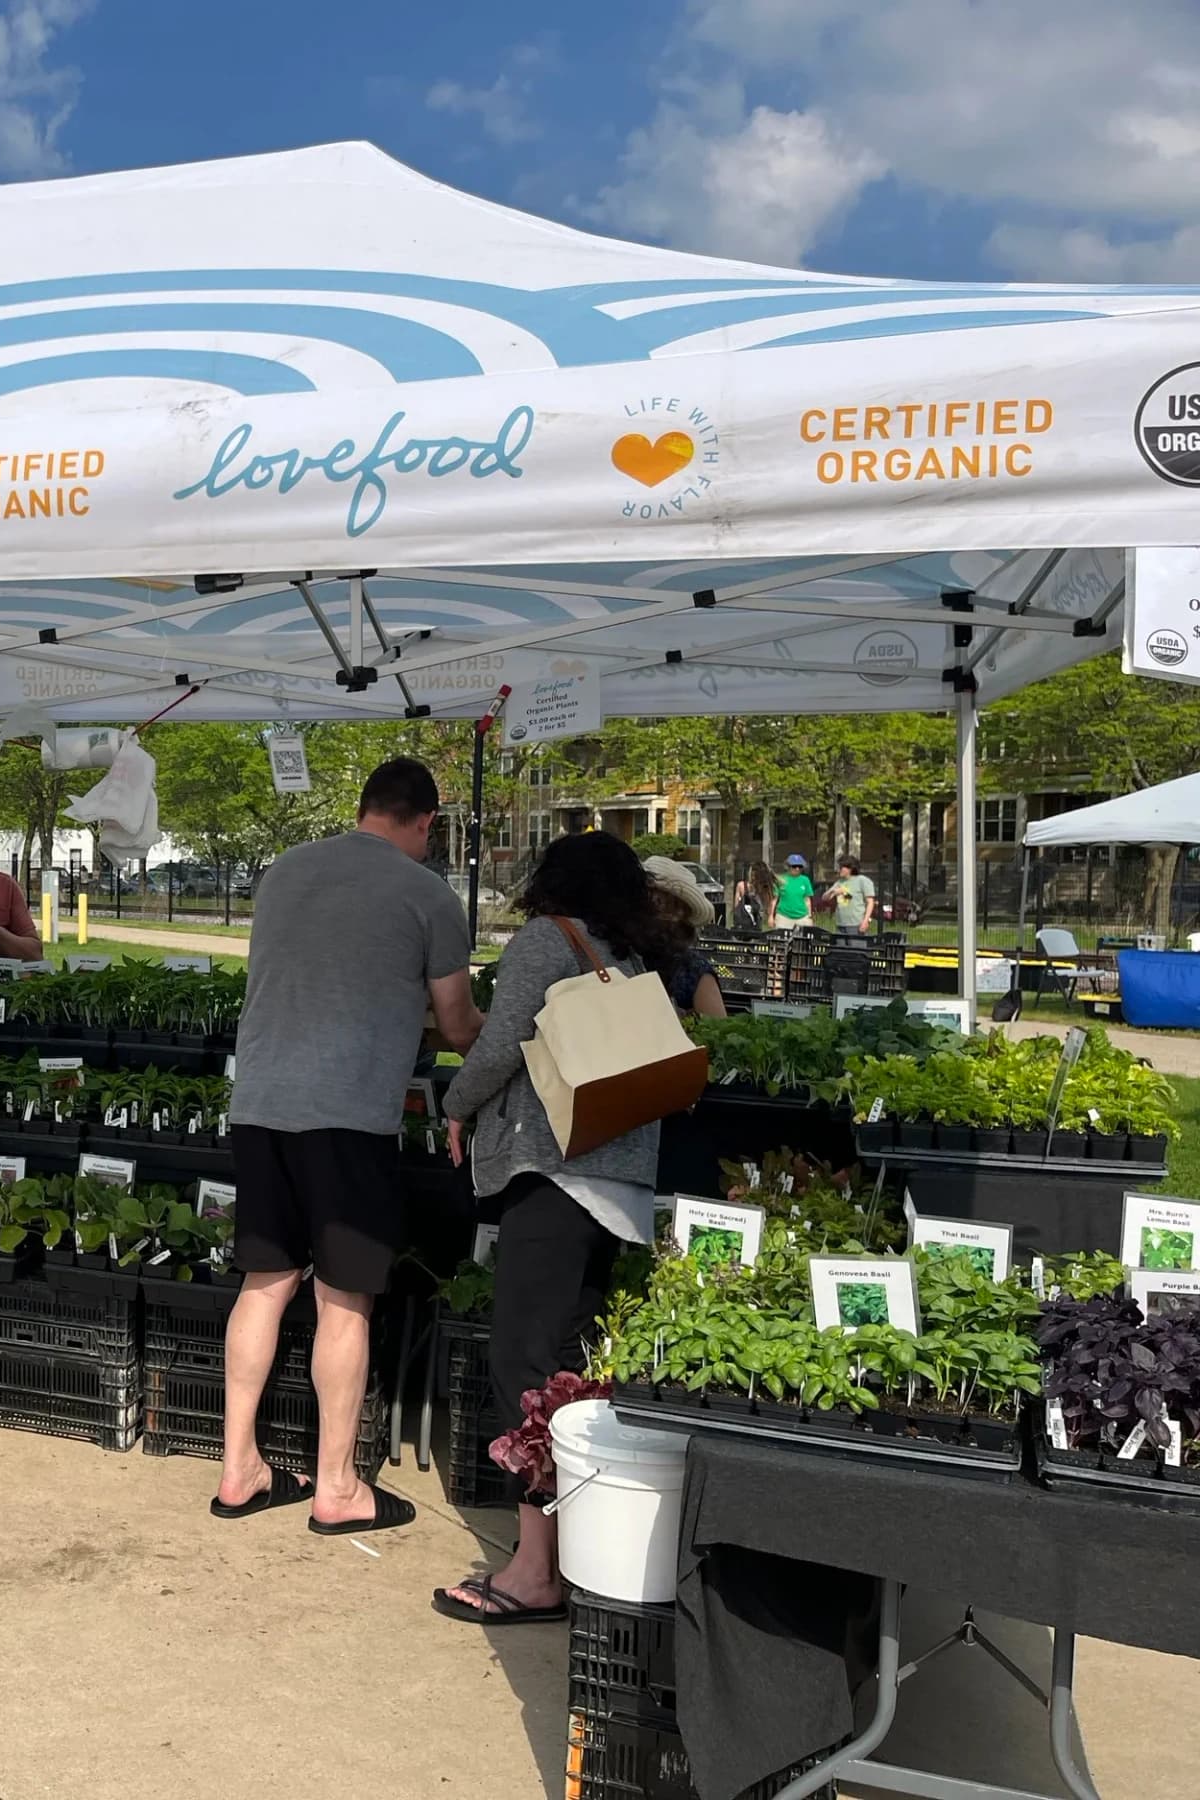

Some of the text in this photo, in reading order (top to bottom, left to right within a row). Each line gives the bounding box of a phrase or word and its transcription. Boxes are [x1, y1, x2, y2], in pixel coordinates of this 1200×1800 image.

[800, 400, 1053, 443] CERTIFIED
[622, 398, 720, 519] LIFE WITH FLAVOR
[817, 443, 1033, 484] ORGANIC
[174, 405, 535, 536] lovefood
[1156, 637, 1179, 647] USDA
[536, 694, 568, 705] Certified
[526, 701, 579, 718] Organic Plants
[1172, 1219, 1191, 1227] Basil
[942, 1230, 980, 1241] Thai Basil
[1162, 1282, 1191, 1290] Purple
